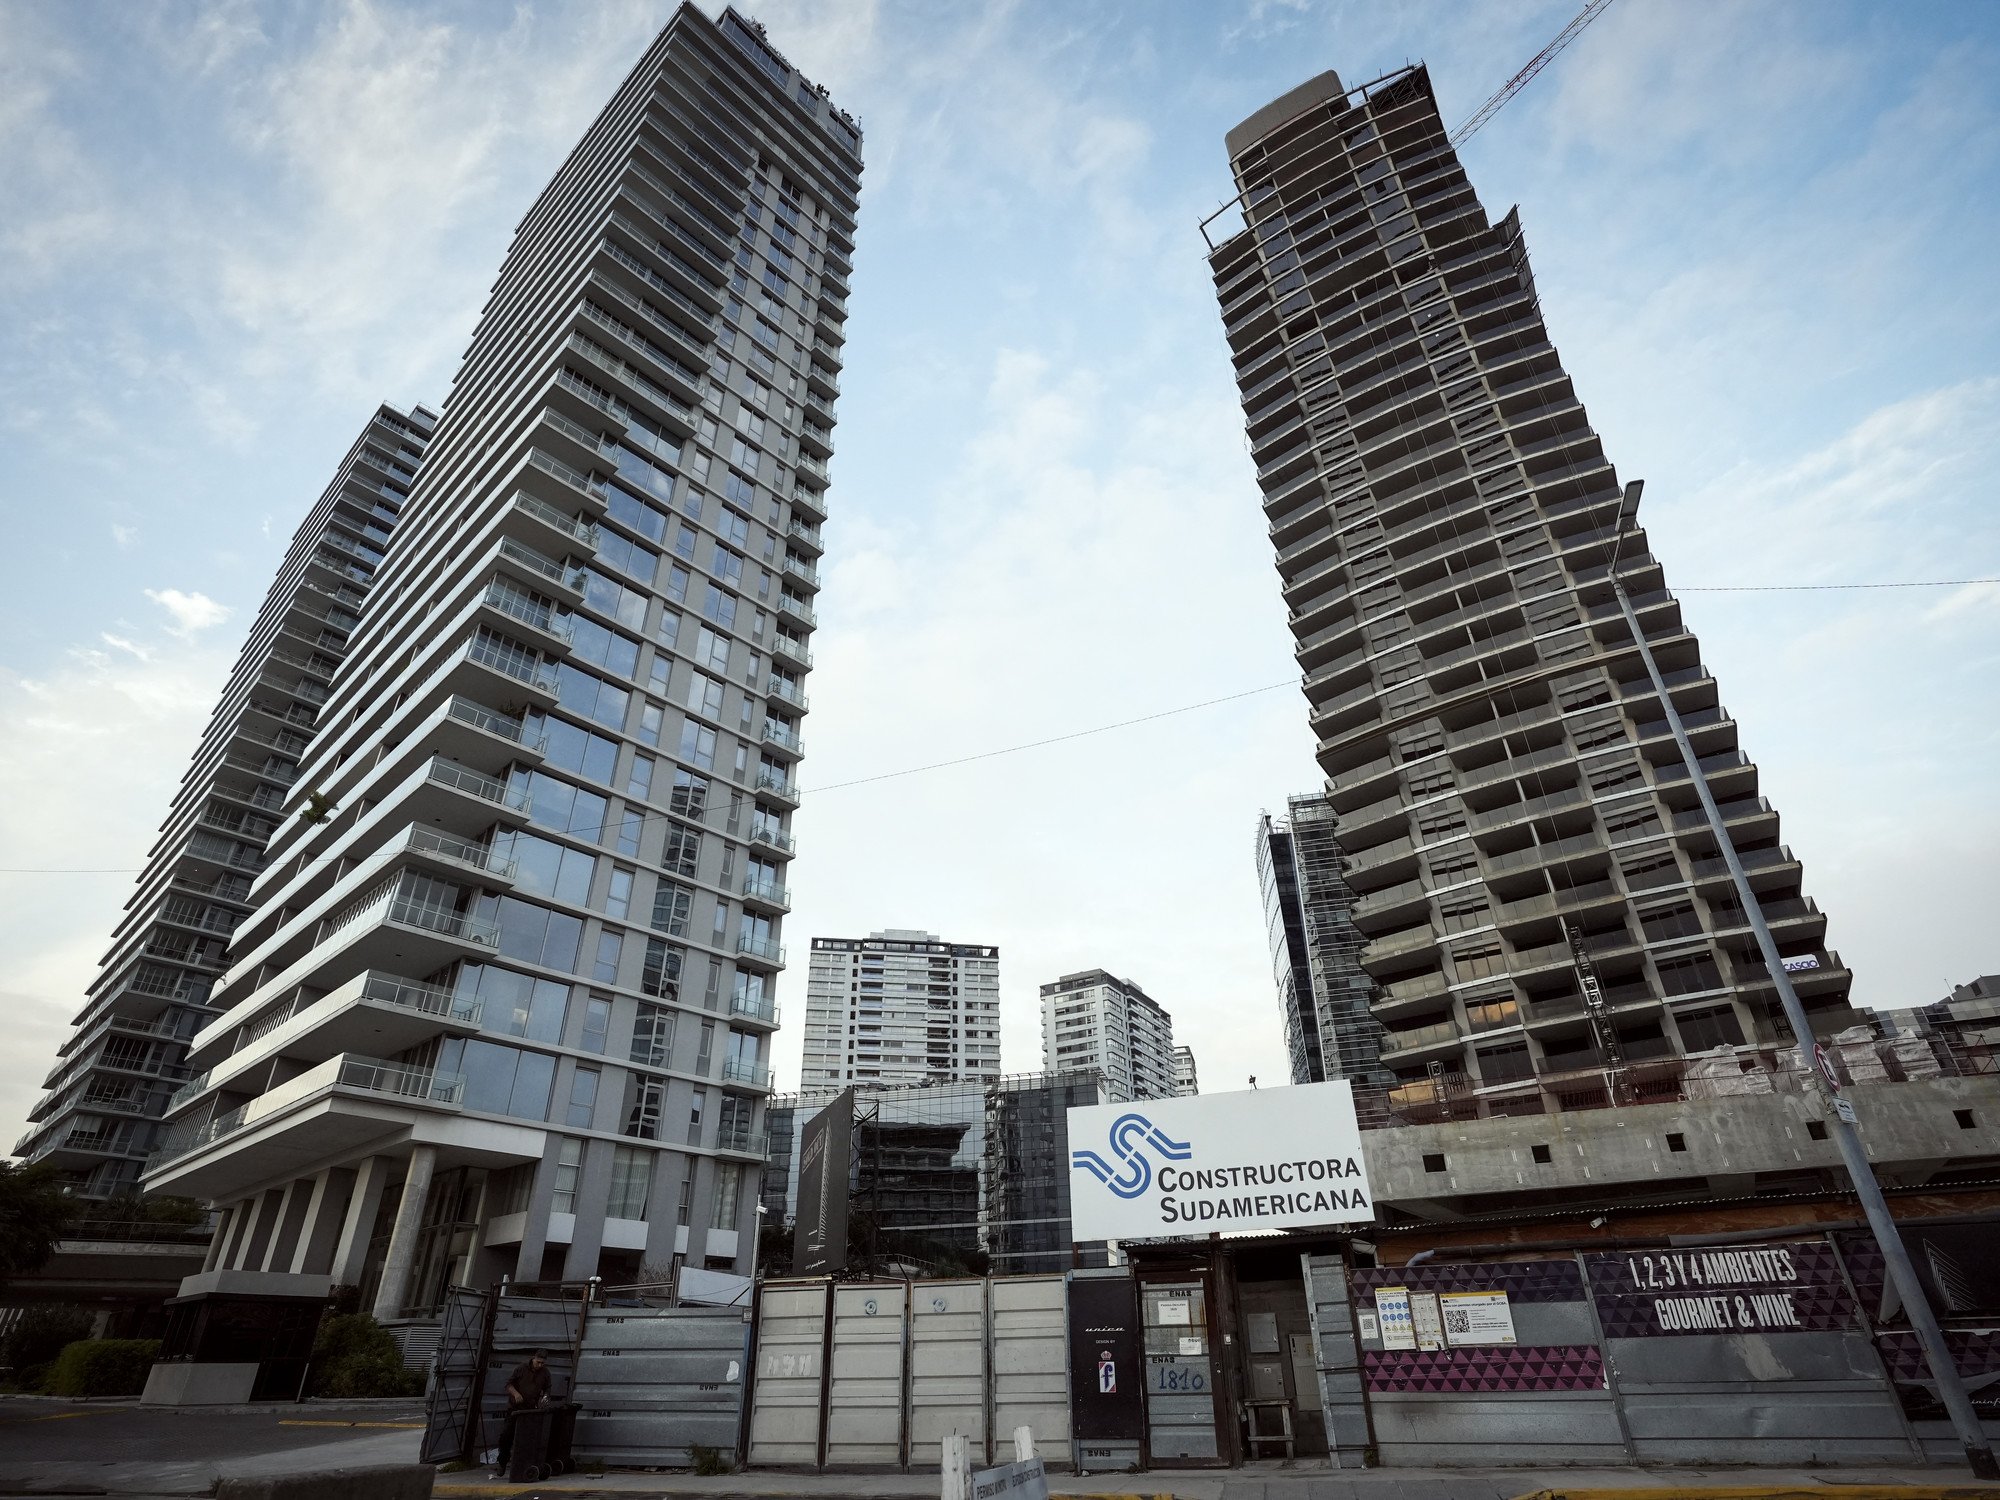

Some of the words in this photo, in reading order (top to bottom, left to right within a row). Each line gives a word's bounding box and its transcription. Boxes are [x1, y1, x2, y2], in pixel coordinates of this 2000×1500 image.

[1158, 1157, 1361, 1192] CONSTRUCTORA
[1160, 1188, 1368, 1223] SUDAMERICANA
[1660, 1255, 1676, 1286] 3
[1672, 1254, 1688, 1285] Y
[1690, 1254, 1703, 1284] 4
[1702, 1249, 1797, 1284] AMBIENTES
[1654, 1297, 1733, 1330] GOURMET
[1734, 1296, 1755, 1328] &
[1750, 1294, 1801, 1327] WINE
[1159, 1366, 1204, 1390] 1810
